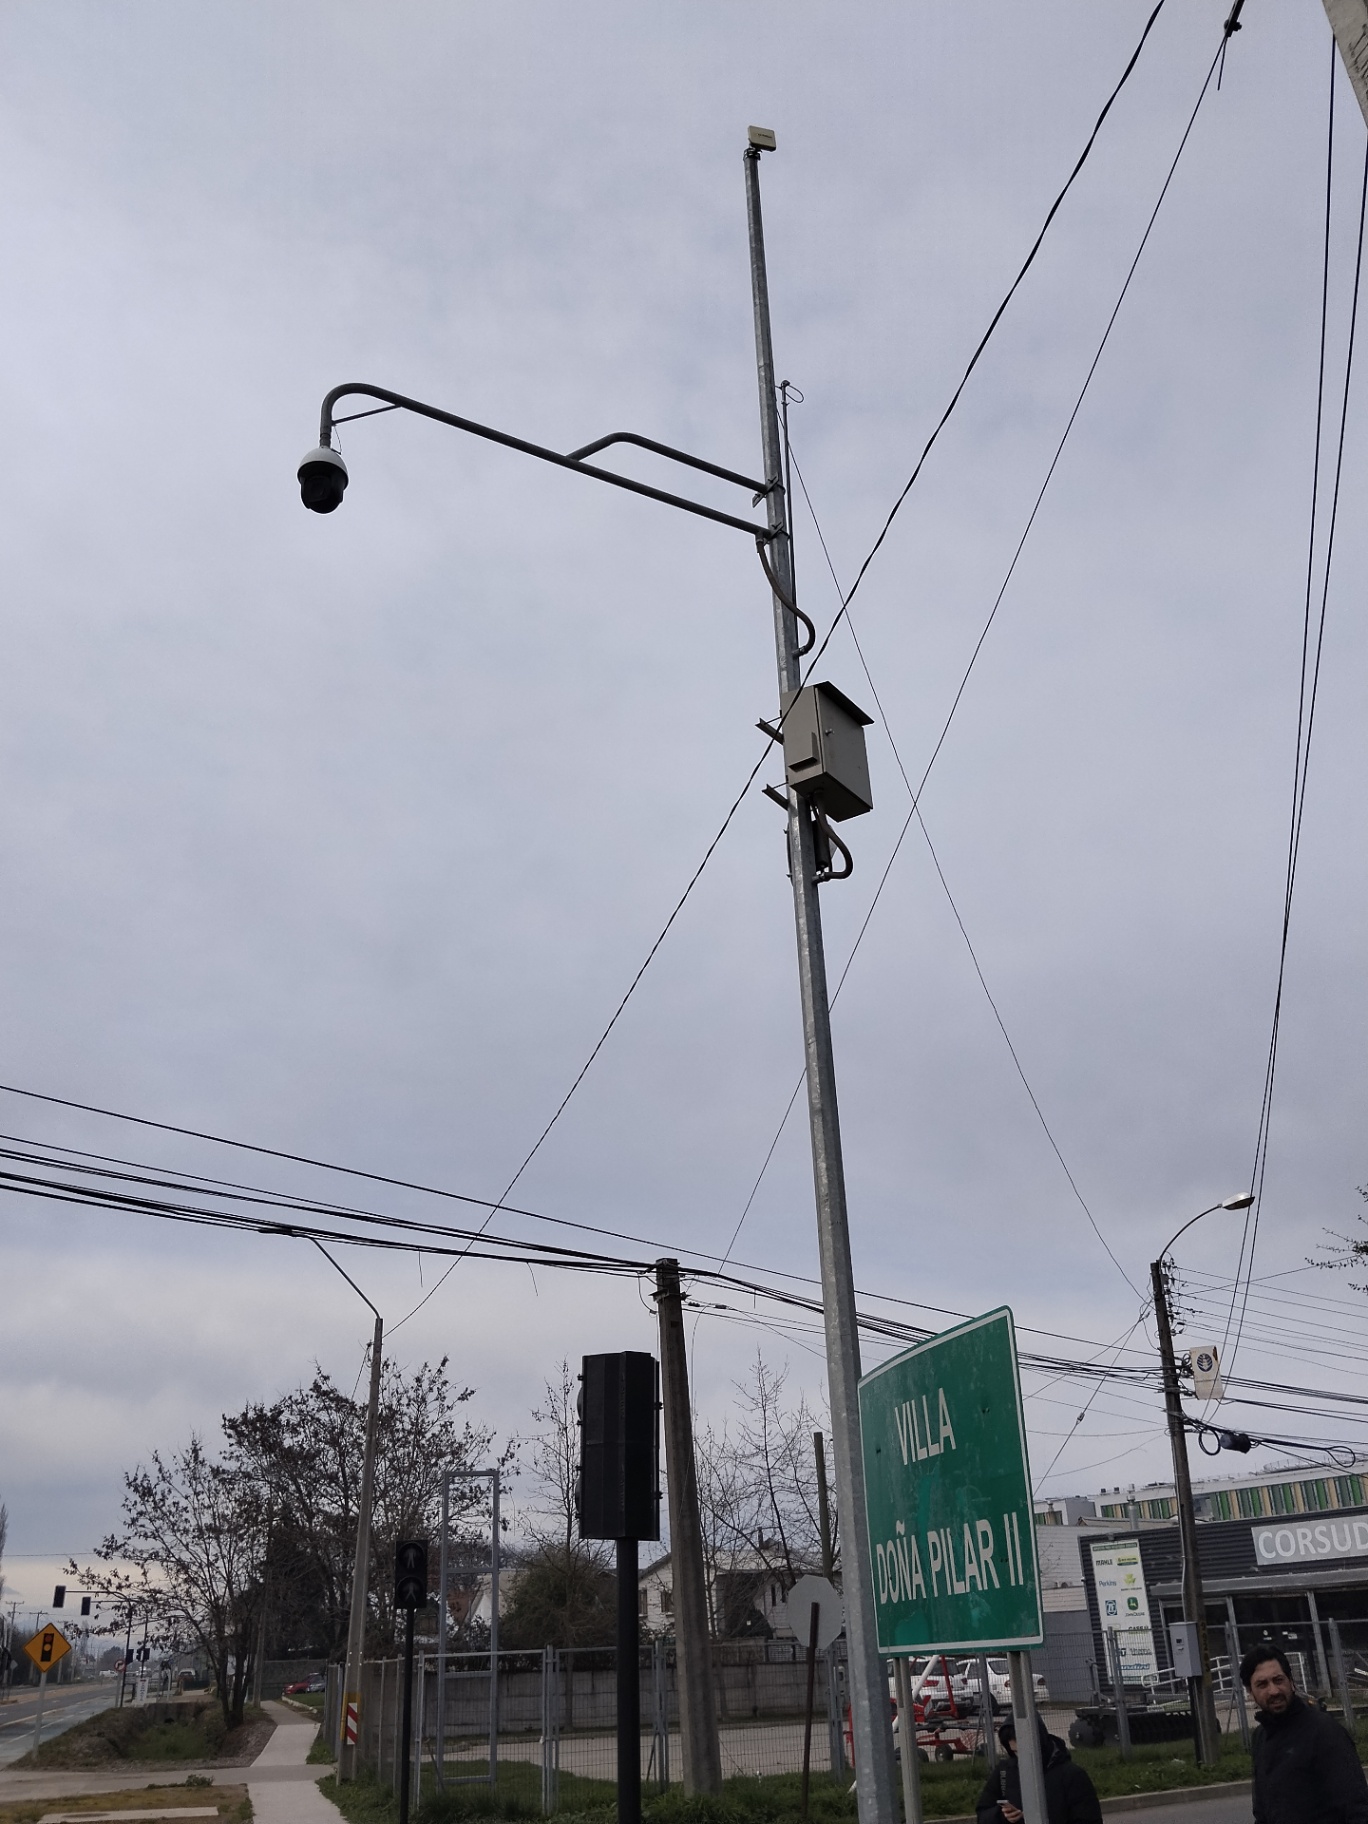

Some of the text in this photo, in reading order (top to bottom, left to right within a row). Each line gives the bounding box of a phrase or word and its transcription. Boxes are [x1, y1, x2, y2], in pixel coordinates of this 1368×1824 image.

[895, 1388, 956, 1465] VILLA
[876, 1512, 1024, 1604] DOÑA PILAR II
[1258, 1522, 1368, 1558] CORSUD
